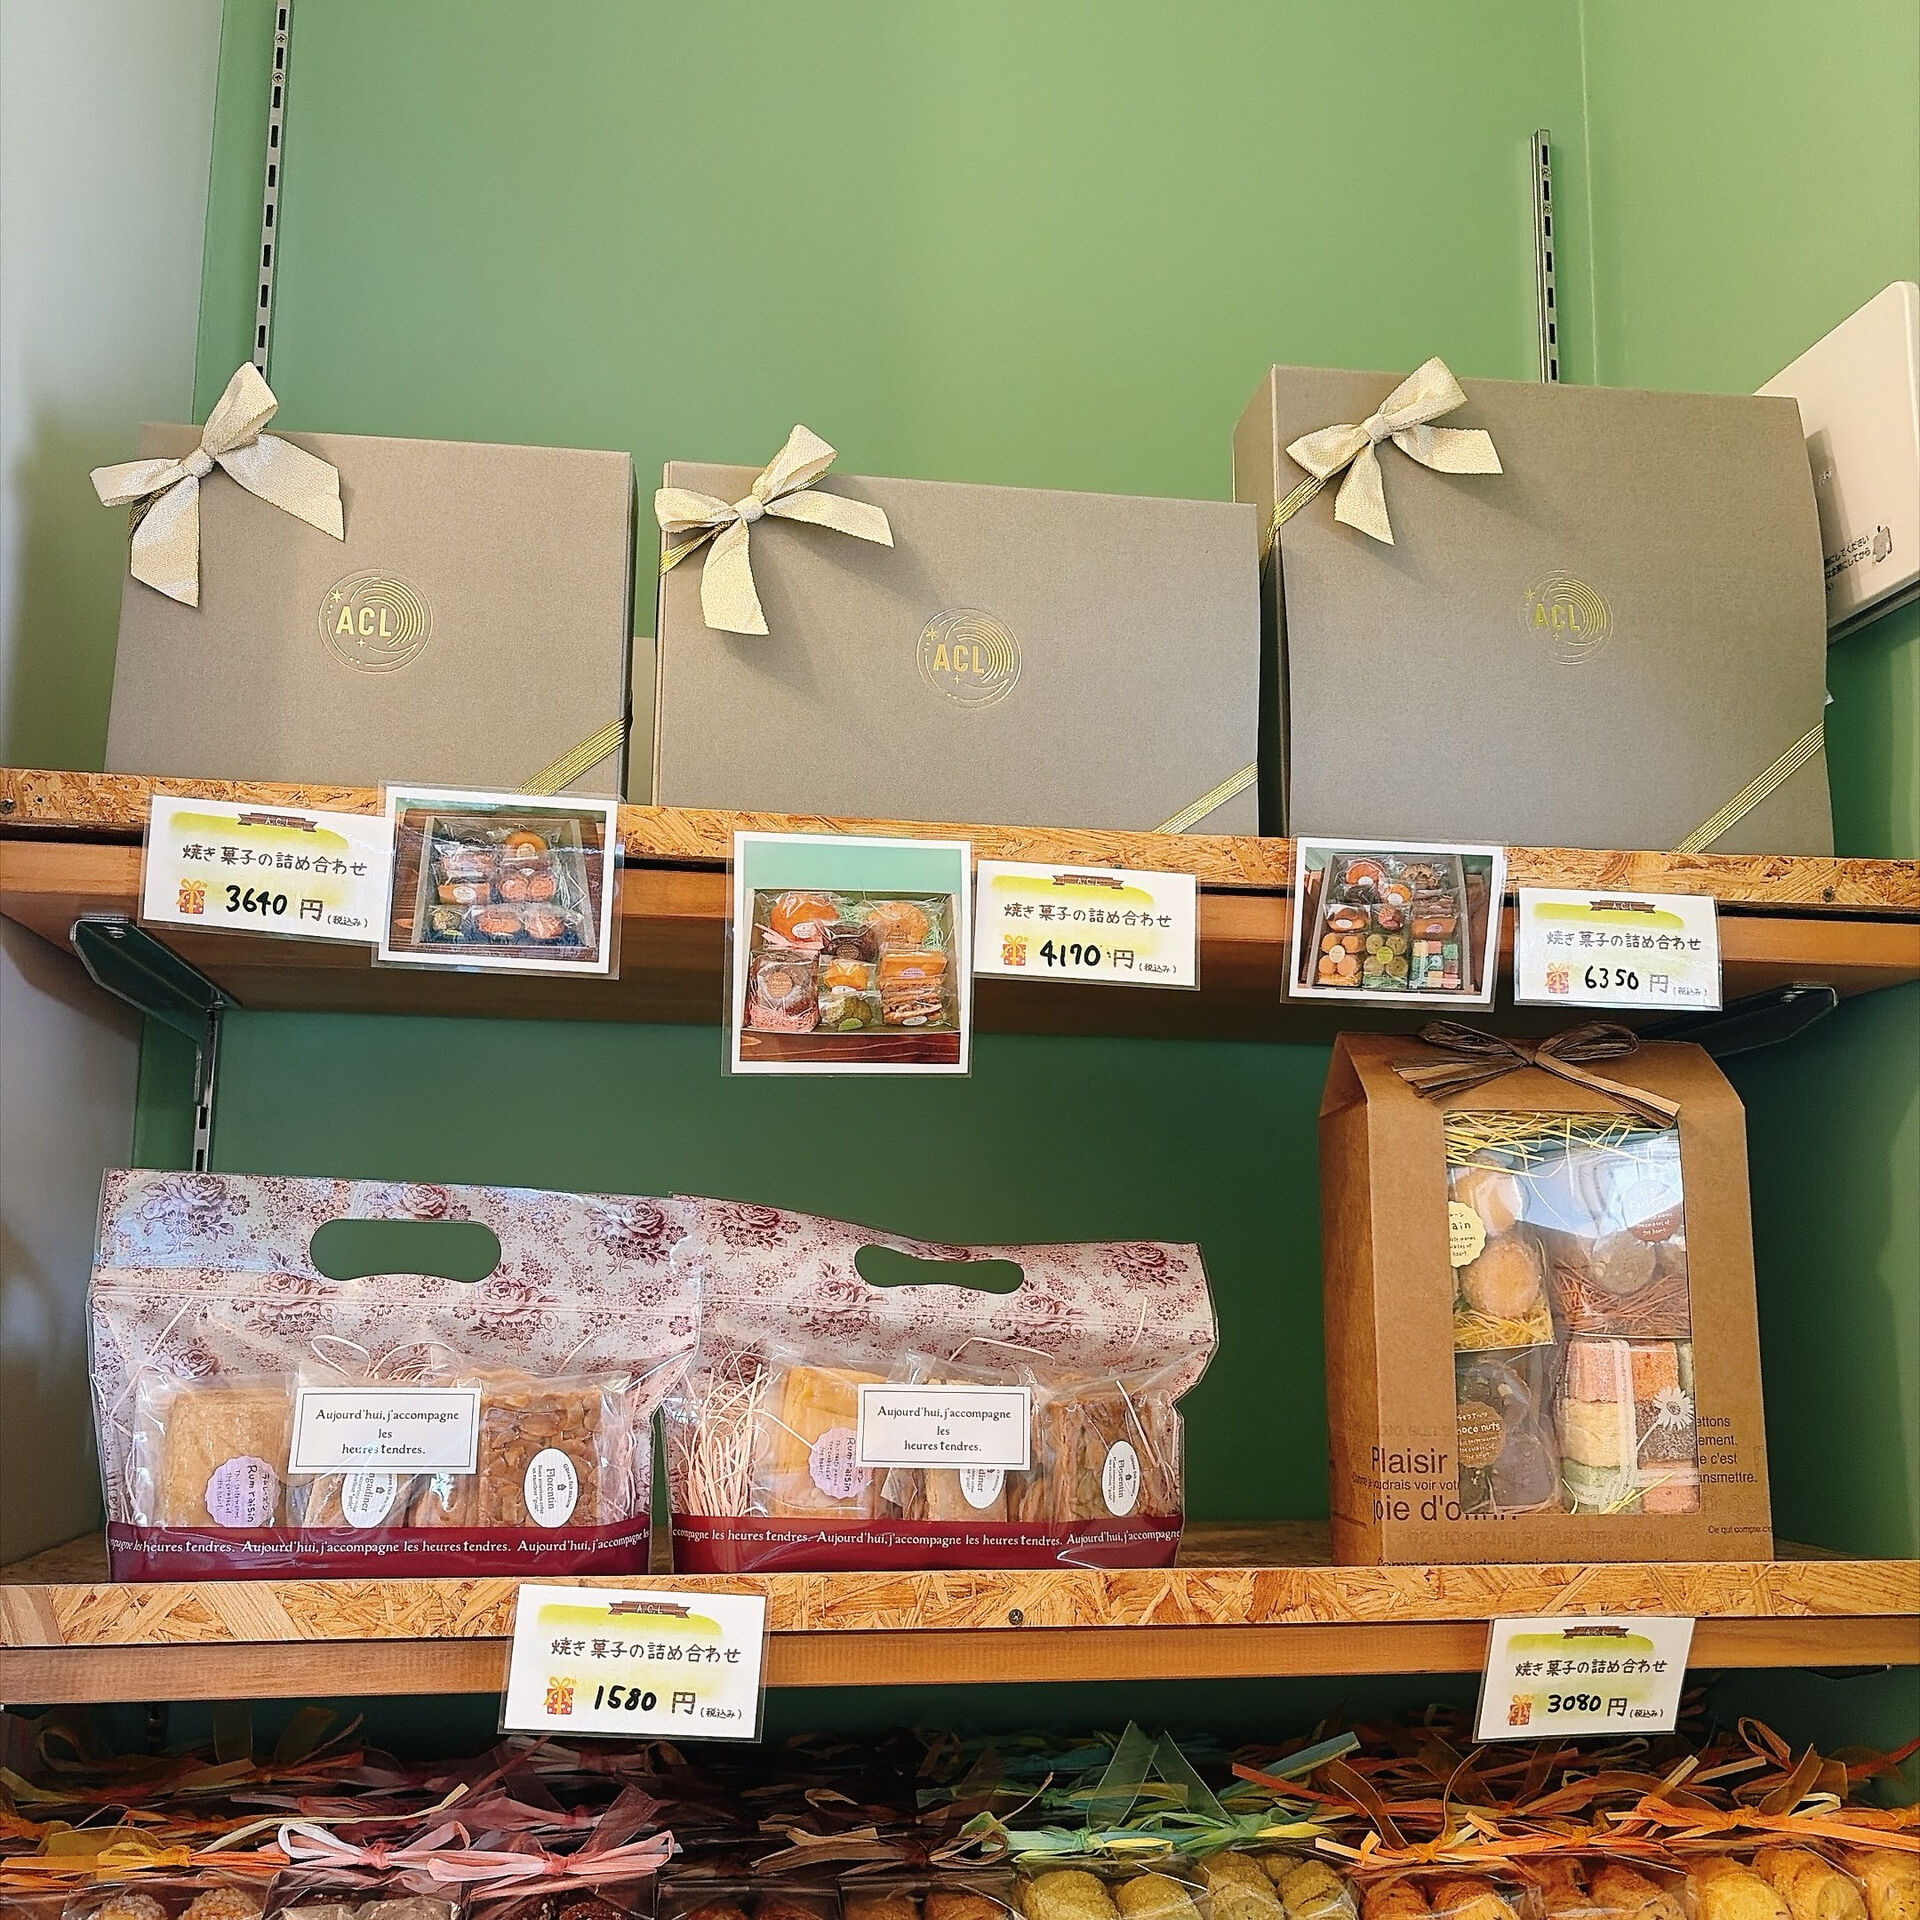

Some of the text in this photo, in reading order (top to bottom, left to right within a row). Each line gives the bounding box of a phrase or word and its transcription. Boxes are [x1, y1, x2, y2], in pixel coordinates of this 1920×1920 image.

[335, 604, 392, 637] ACL
[1535, 603, 1580, 631] ACL
[932, 643, 985, 674] ACL
[182, 843, 368, 877] 焼き菓子の詰め合わせ
[225, 884, 288, 917] 3640
[1003, 902, 1172, 928] 焼き菓子の詰め合わせ
[1546, 930, 1702, 951] 焼き菓子の詰め合わせ
[1039, 940, 1101, 967] 4170
[1585, 965, 1639, 990] 6350
[378, 1428, 393, 1439] les
[936, 1425, 950, 1436] les
[342, 1443, 426, 1454] heures tendres.
[904, 1440, 982, 1452] heures tendres.
[1710, 1453, 1737, 1464] c'est
[1371, 1446, 1448, 1474] Plaisir
[246, 1464, 258, 1523] Rum raisin
[546, 1468, 556, 1509] Florentin
[1414, 1479, 1437, 1490] voir
[143, 1540, 183, 1552] heures
[185, 1540, 235, 1553] tendres.
[403, 1540, 419, 1552] les
[422, 1540, 461, 1552] heures
[462, 1540, 511, 1552] tendres.
[711, 1529, 725, 1541] les
[727, 1529, 764, 1542] heures
[765, 1530, 811, 1542] tendres.
[965, 1534, 980, 1545] les
[982, 1534, 1019, 1546] heures
[1020, 1534, 1063, 1546] tendres.
[551, 1637, 742, 1664] 焼き菓子の詰め合わせ
[1515, 1658, 1668, 1677] 焼き菓子の詰め合わせ
[594, 1685, 657, 1712] 1580
[1547, 1693, 1602, 1713] 3080
